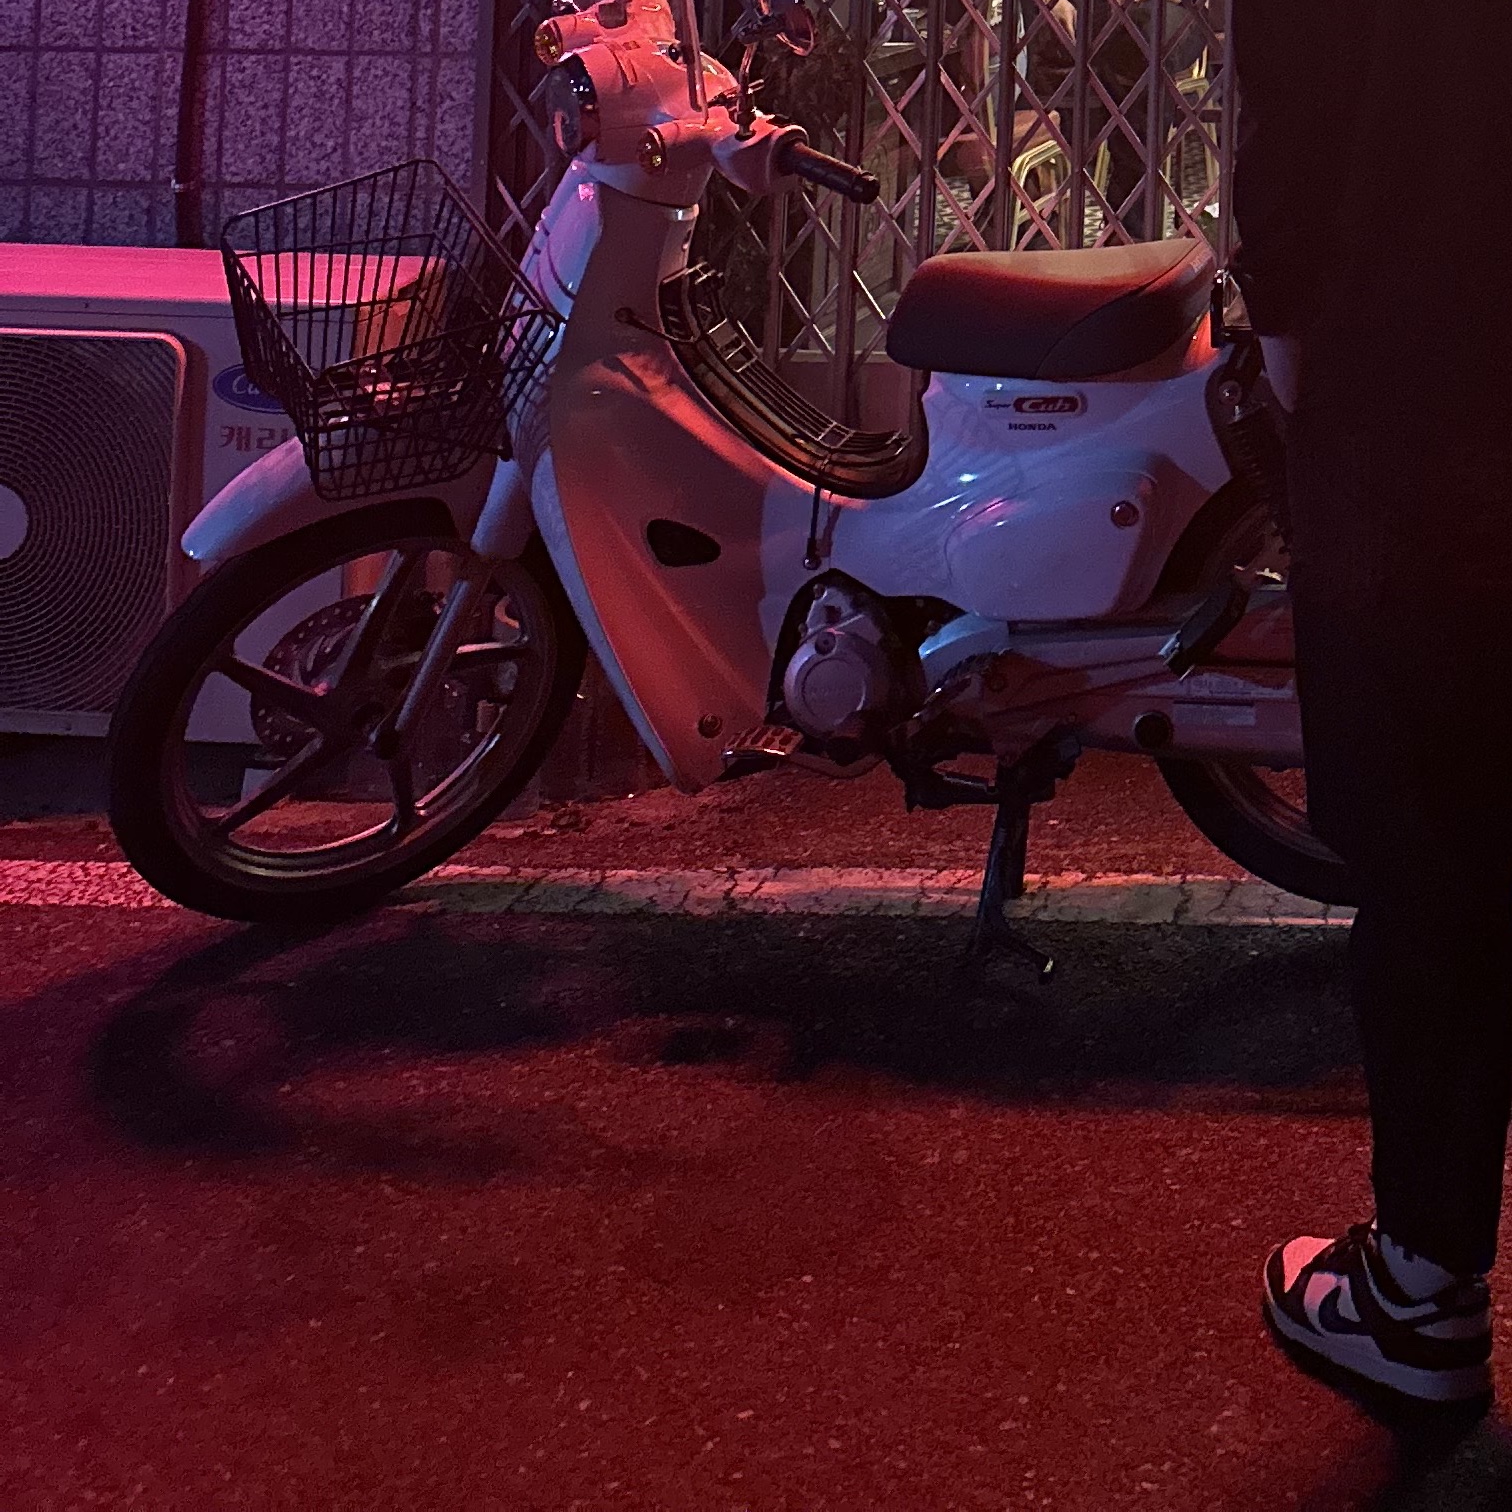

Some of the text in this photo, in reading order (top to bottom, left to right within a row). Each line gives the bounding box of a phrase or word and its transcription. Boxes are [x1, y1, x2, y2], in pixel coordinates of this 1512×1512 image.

[985, 397, 1072, 412] Super Cub
[1008, 423, 1057, 431] HONDA
[220, 426, 289, 452] 캐리
